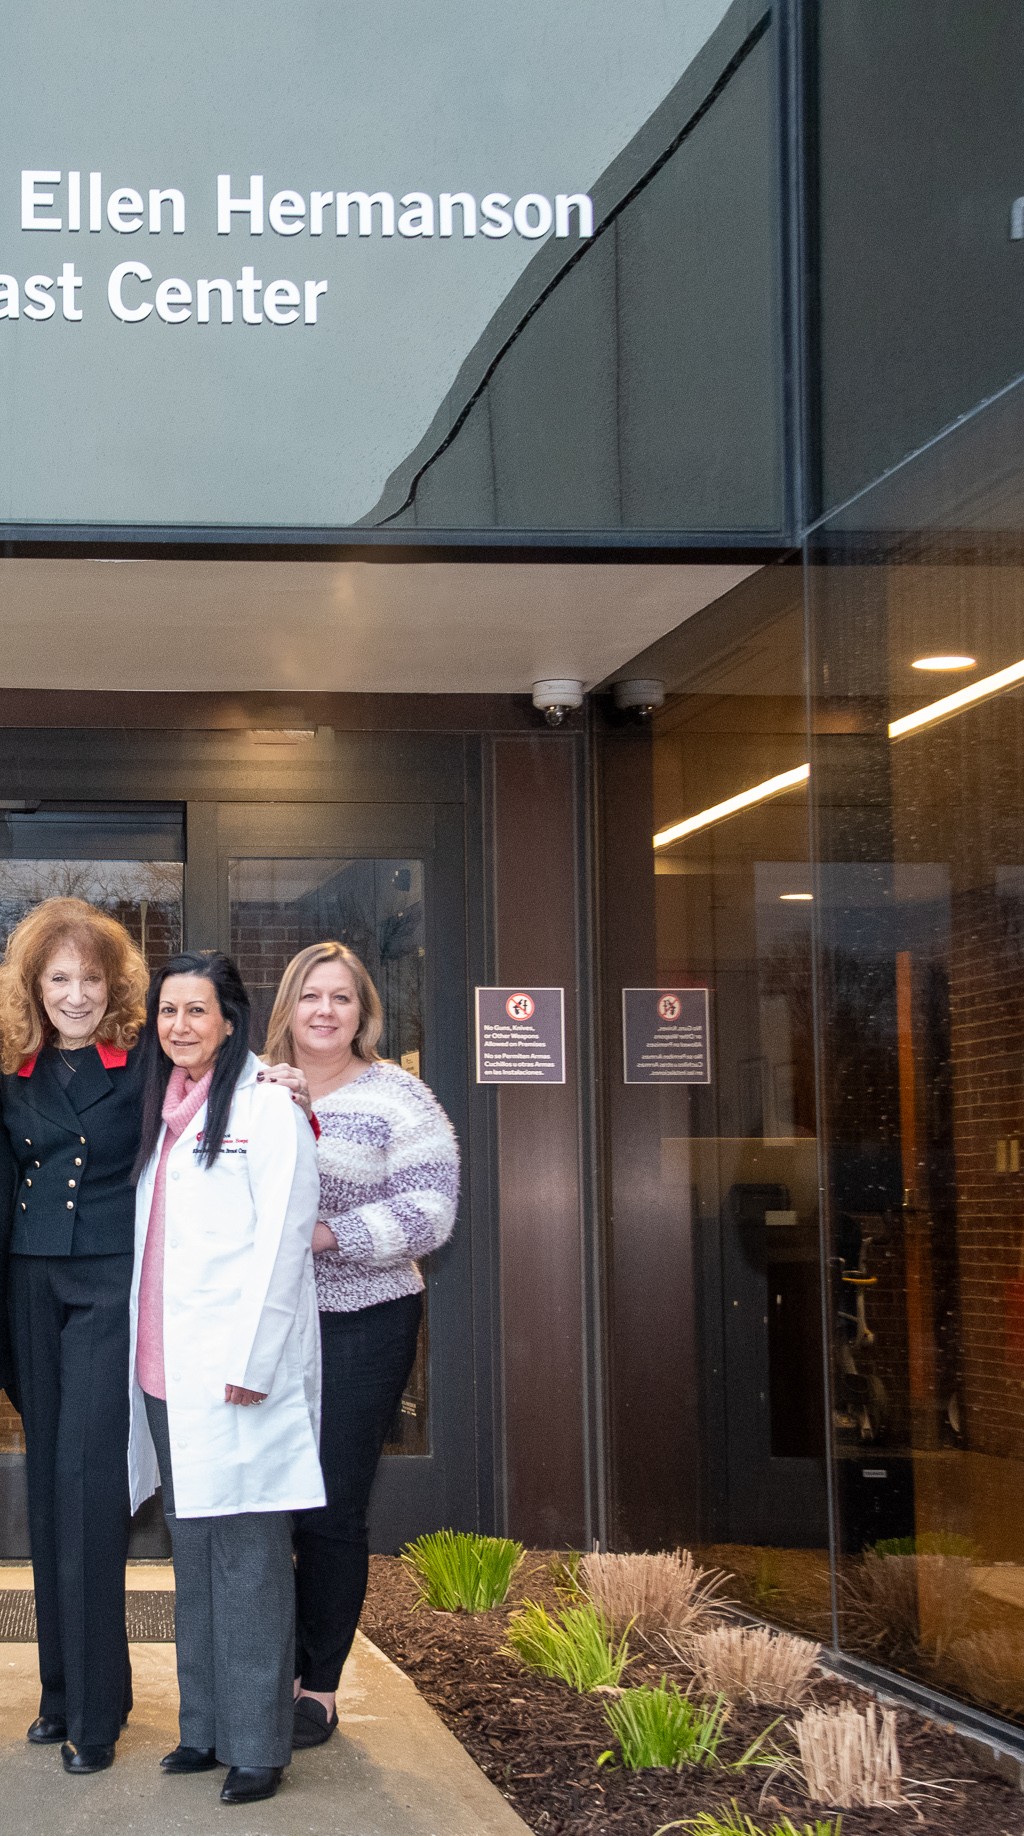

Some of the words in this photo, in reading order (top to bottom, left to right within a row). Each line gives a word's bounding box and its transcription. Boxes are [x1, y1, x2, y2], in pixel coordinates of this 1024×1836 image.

[21, 169, 186, 234] Ellen
[217, 173, 593, 239] Hermanson
[107, 259, 329, 325] Center
